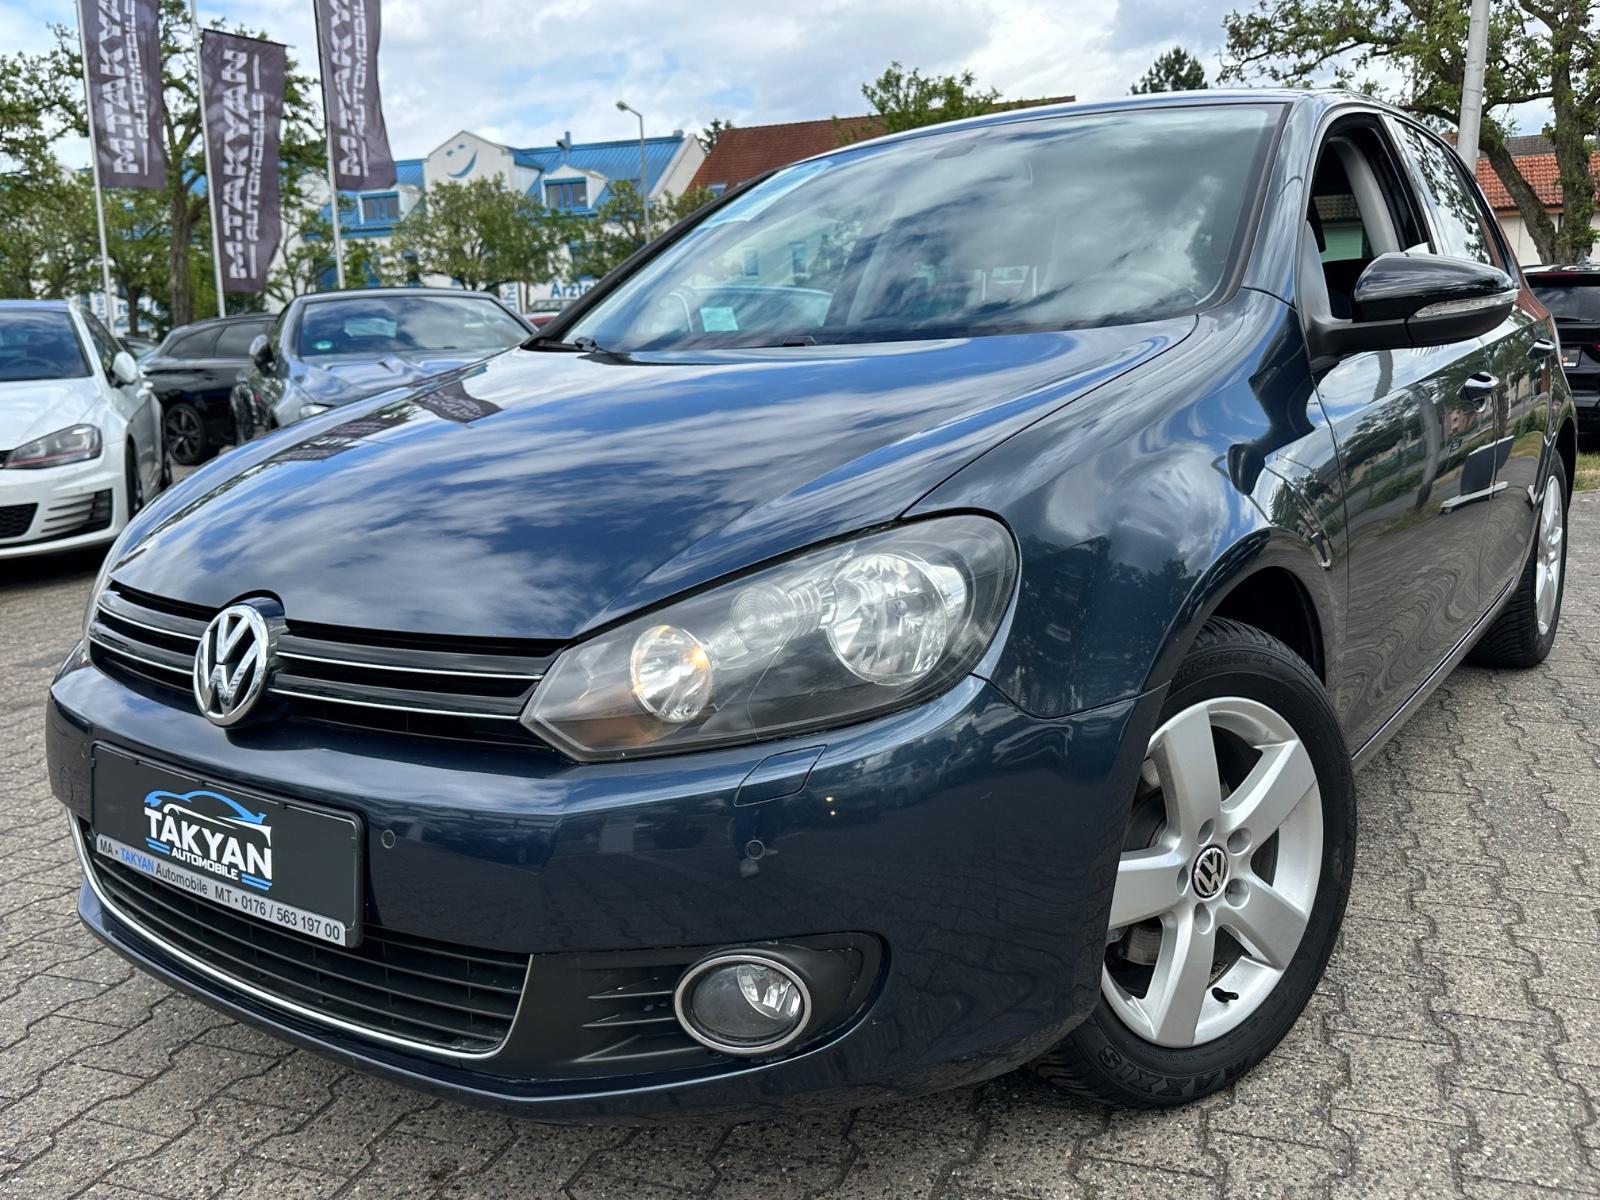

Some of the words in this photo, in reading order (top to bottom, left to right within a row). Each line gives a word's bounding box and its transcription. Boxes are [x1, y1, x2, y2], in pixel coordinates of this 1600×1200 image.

[329, 0, 361, 176] M.TAKY
[221, 48, 250, 279] M.TAKYAN
[246, 93, 265, 242] AUTOMOBILE
[100, 839, 114, 855] MA
[120, 847, 155, 873] TAKYAN
[155, 863, 208, 894] Automobile
[241, 895, 267, 916] 0176
[277, 907, 297, 926] 563
[301, 915, 321, 934] 197
[324, 922, 341, 940] 00
[143, 806, 272, 881] TAKYAN
[171, 847, 239, 881] AUTOMOBILE
[1100, 1045, 1249, 1098] MAXXIS
